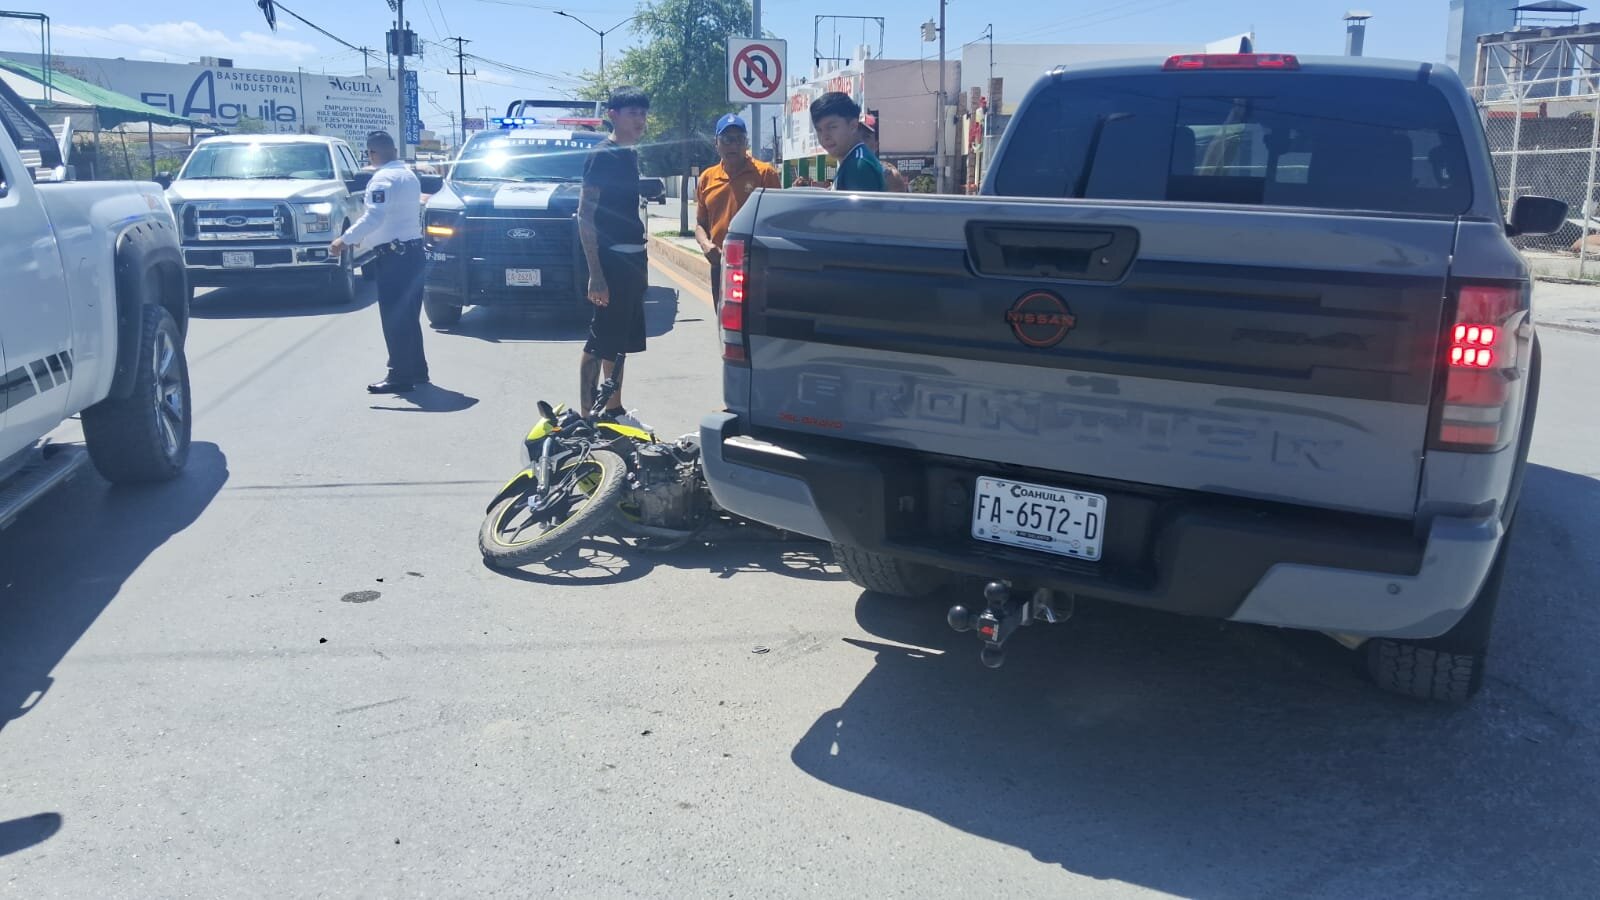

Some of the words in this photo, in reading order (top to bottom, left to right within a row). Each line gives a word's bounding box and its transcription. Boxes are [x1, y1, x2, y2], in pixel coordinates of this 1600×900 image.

[231, 83, 297, 95] INDUSTRIAL
[364, 106, 387, 114] CINTAS
[1007, 311, 1075, 327] NISSAN
[797, 371, 1345, 472] FRONTIER
[1010, 485, 1066, 503] COAHUILA
[977, 494, 1098, 540] FA-6572-D
